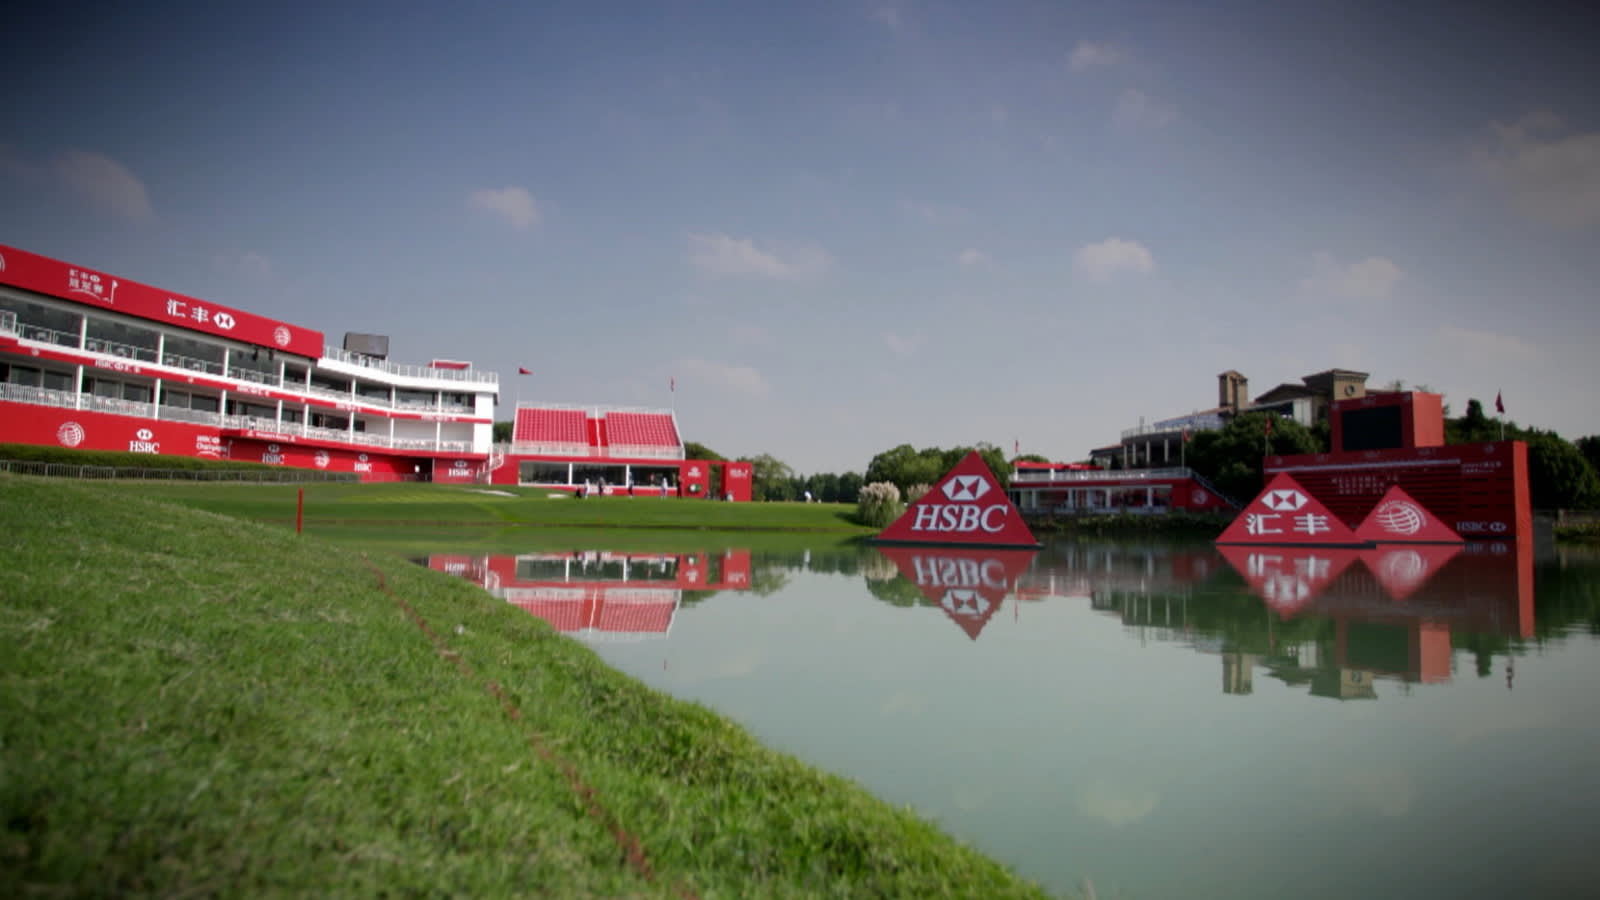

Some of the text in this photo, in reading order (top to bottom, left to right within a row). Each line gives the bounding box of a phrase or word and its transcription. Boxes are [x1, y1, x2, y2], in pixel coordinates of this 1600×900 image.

[166, 298, 209, 323] 汇丰
[129, 440, 160, 455] HSBC
[912, 503, 1008, 533] HSBC
[1246, 513, 1331, 535] 汇丰
